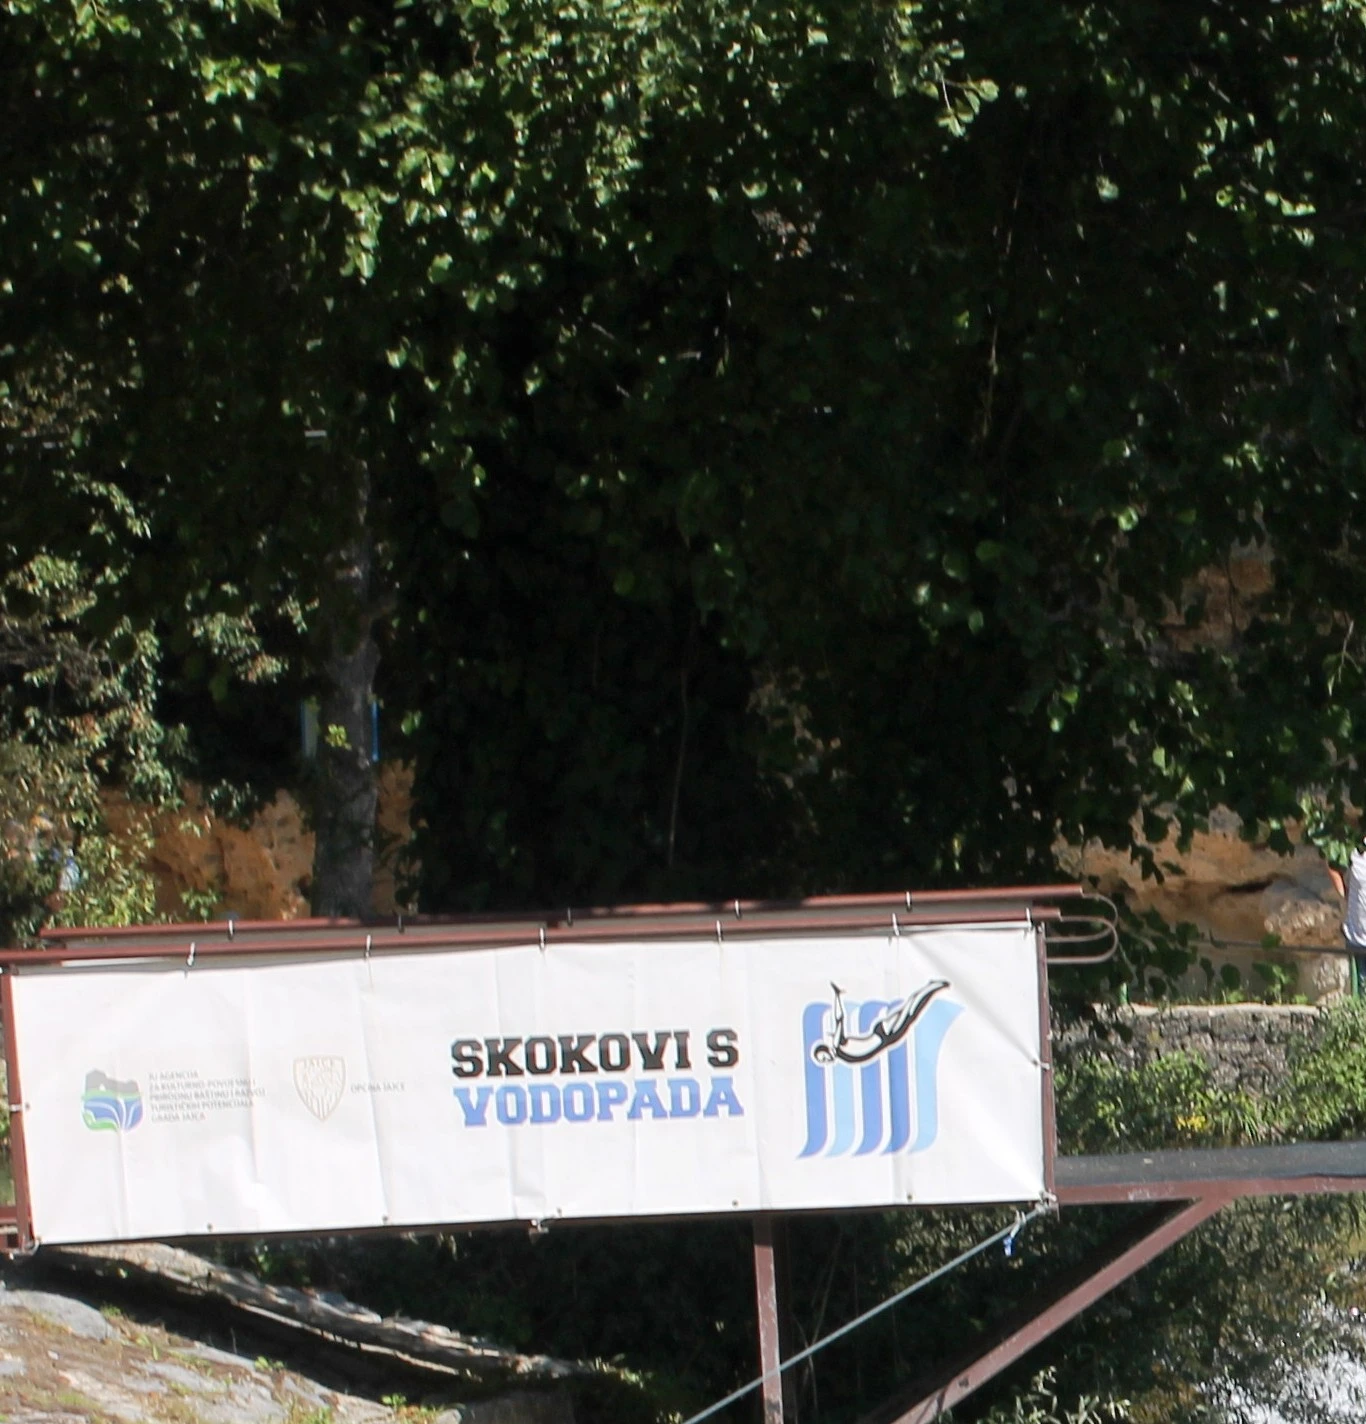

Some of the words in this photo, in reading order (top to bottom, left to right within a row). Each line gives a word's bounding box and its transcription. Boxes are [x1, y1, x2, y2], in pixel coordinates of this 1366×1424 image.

[160, 1070, 199, 1080] AGENCIJA
[450, 1030, 692, 1079] SKOKOVI
[706, 1028, 740, 1069] S
[453, 1076, 745, 1127] VODOPADA
